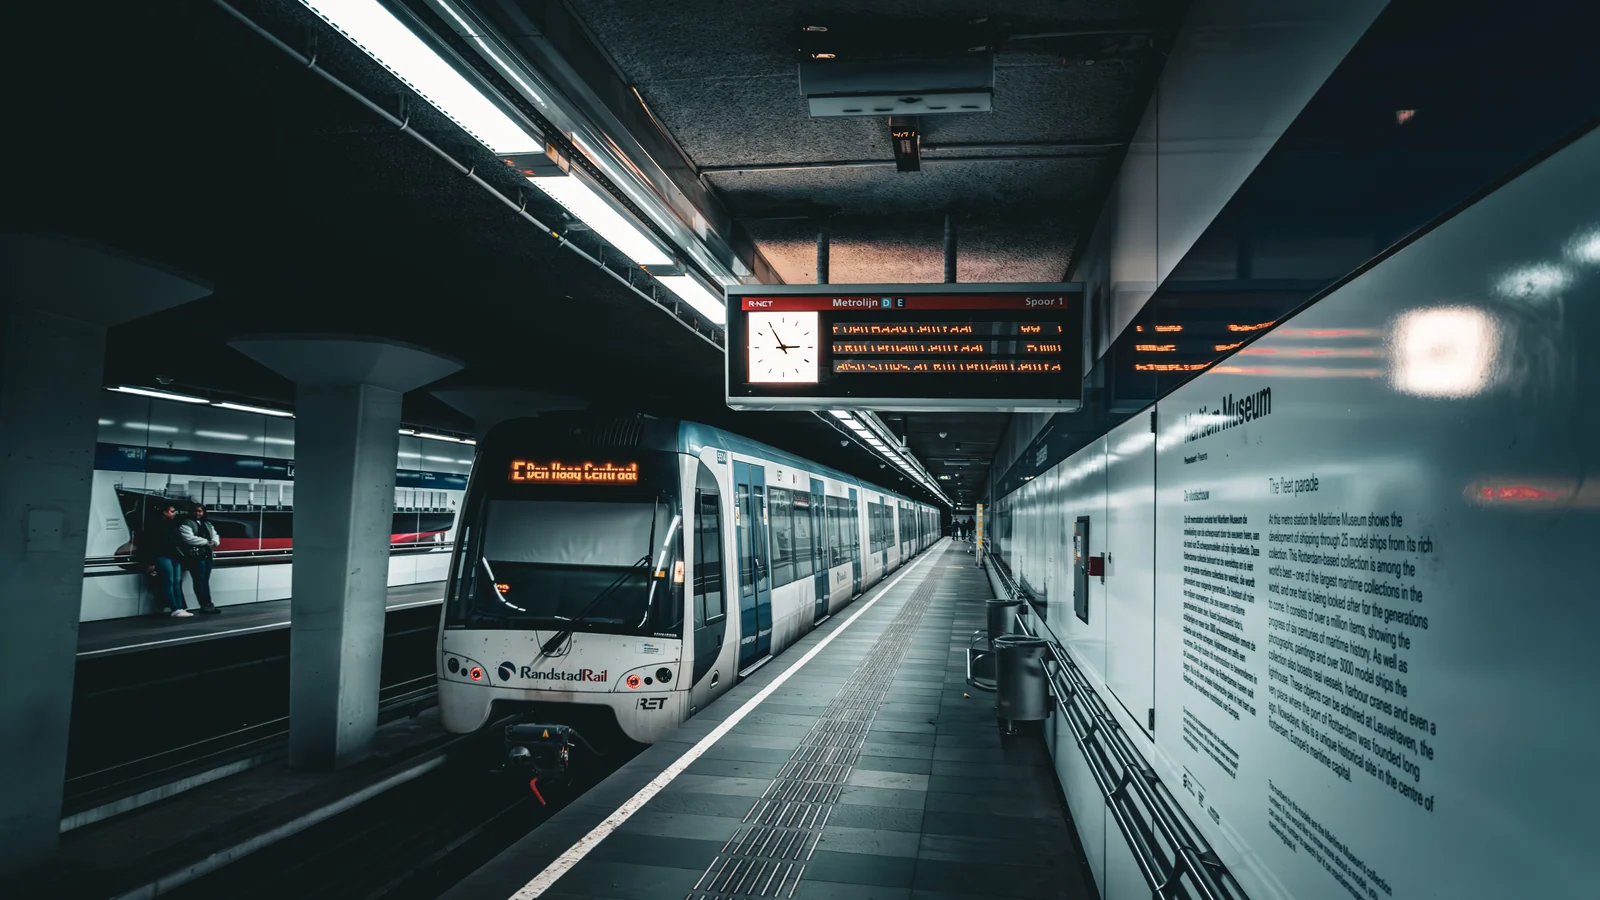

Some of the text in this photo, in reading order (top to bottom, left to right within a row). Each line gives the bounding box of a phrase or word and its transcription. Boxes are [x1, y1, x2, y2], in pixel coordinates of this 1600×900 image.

[832, 298, 878, 308] Metrolijn
[1025, 297, 1063, 307] Spoor 1
[1222, 386, 1271, 430] Museum
[1268, 473, 1319, 497] The fleet parade
[1368, 512, 1389, 527] shows
[1390, 511, 1402, 527] the
[1369, 534, 1387, 552] ships
[1388, 534, 1405, 551] from
[1407, 535, 1416, 552] its
[1417, 536, 1433, 553] rich
[1377, 561, 1401, 579] among
[1402, 560, 1415, 577] the
[1364, 579, 1400, 598] collections
[1401, 583, 1408, 600] in
[1410, 585, 1422, 603] the
[1361, 599, 1371, 615] for
[1372, 602, 1383, 618] the
[1384, 609, 1428, 629] generations
[1368, 624, 1396, 649] showing
[1398, 632, 1410, 649] the
[1372, 647, 1382, 664] As
[1383, 653, 1397, 669] well
[1398, 660, 1407, 673] as
[520, 666, 607, 682] RandstadRail
[1375, 672, 1393, 693] ships
[1395, 679, 1407, 697] the
[636, 698, 668, 710] RET
[1369, 696, 1392, 715] cranes
[1393, 706, 1407, 722] and
[1409, 713, 1428, 731] even
[1365, 716, 1372, 729] at
[1420, 740, 1433, 760] the
[1358, 735, 1371, 750] was
[1372, 738, 1401, 767] founded
[1402, 754, 1420, 782] long
[1365, 758, 1377, 776] site
[1377, 764, 1384, 781] in
[1385, 770, 1397, 789] the
[1398, 781, 1423, 805] centre
[1424, 795, 1434, 812] of
